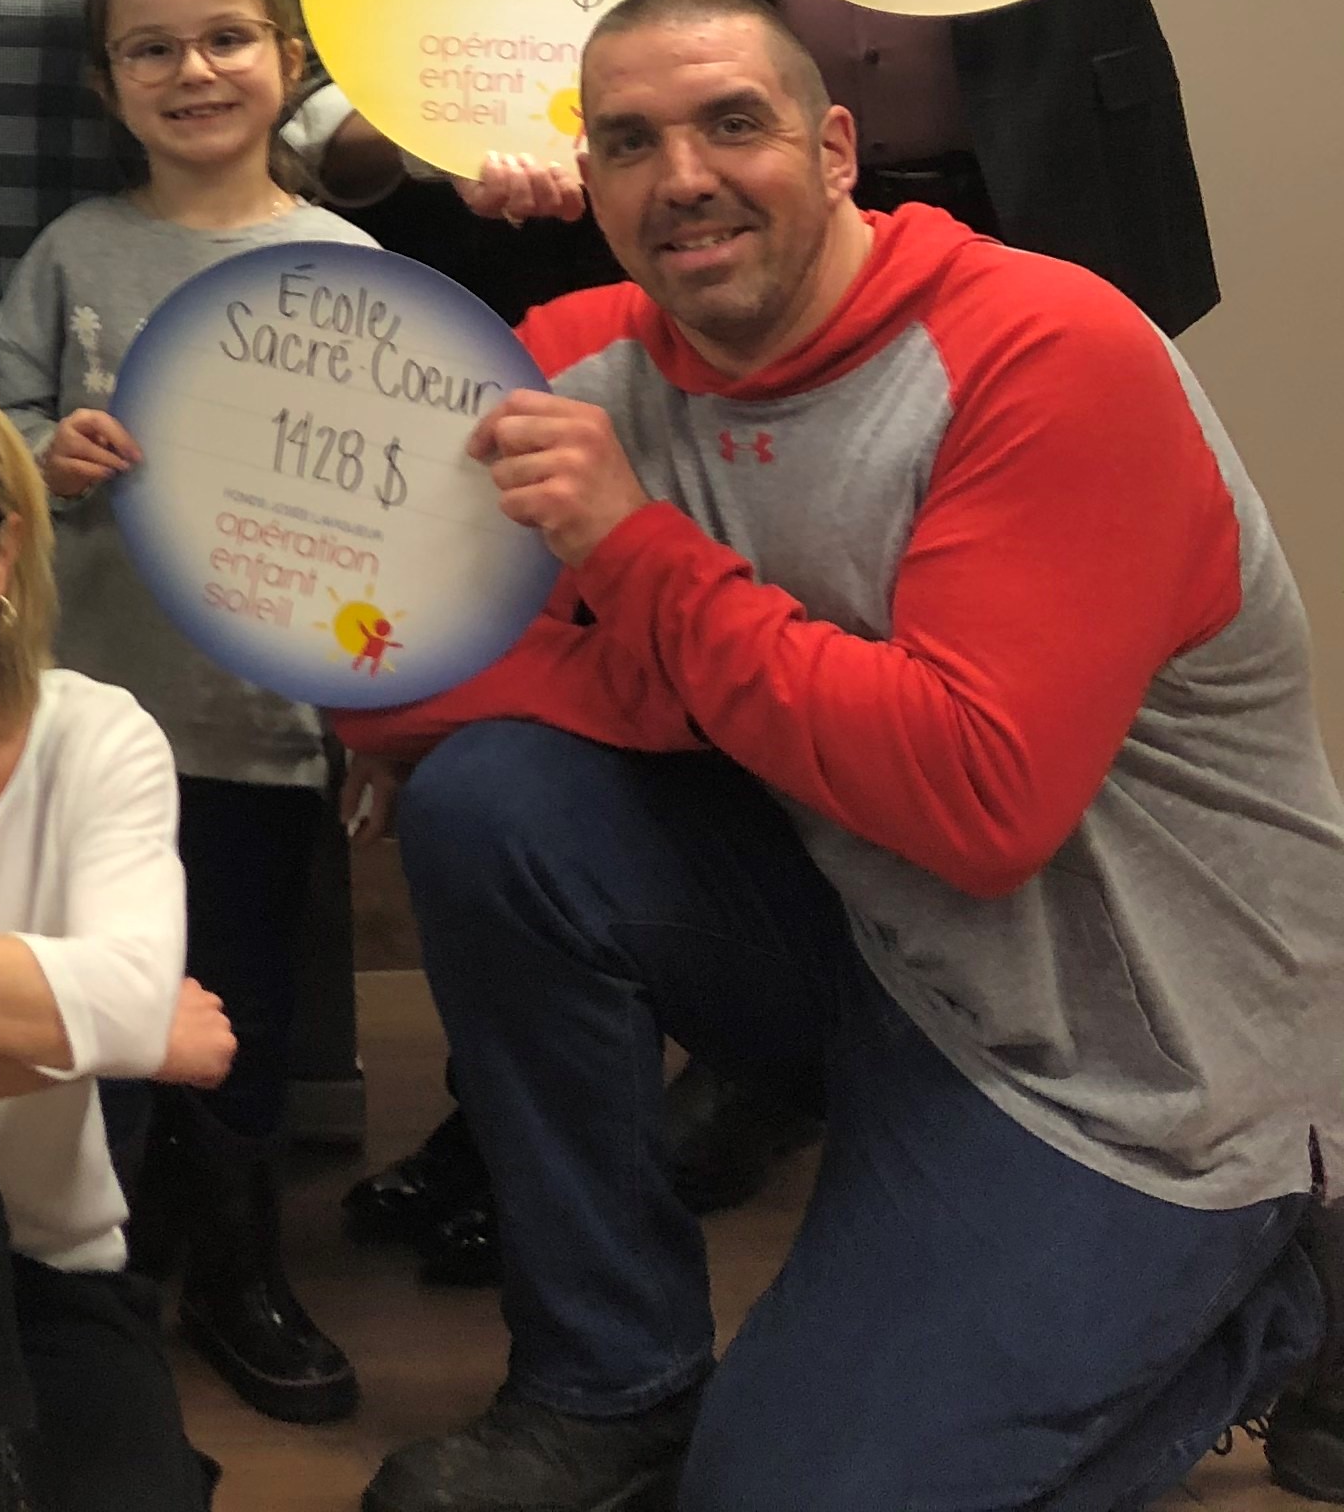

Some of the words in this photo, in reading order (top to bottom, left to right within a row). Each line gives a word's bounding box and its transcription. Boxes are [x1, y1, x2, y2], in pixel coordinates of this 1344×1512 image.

[419, 33, 579, 62] opération
[419, 65, 524, 94] enfant
[420, 100, 507, 126] soleil
[278, 264, 402, 340] École
[215, 511, 380, 577] opération
[209, 545, 318, 598] enfant
[203, 579, 296, 629] soleil
